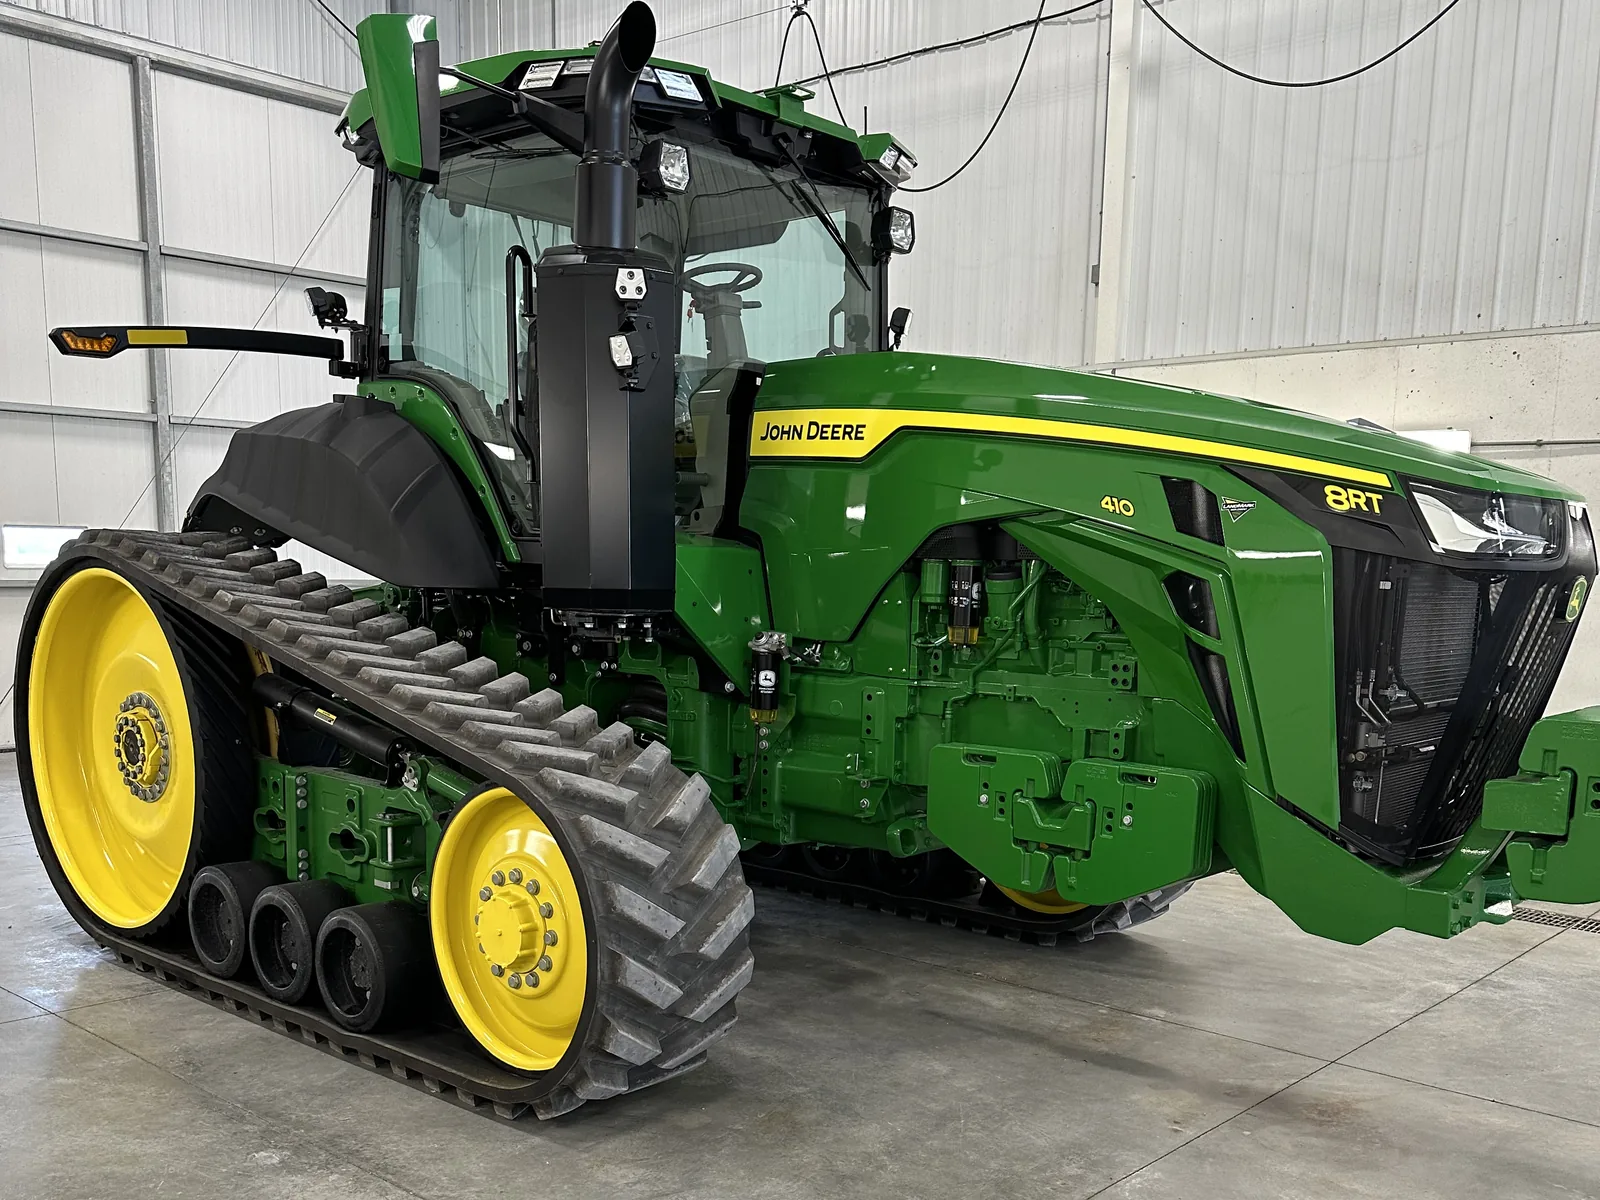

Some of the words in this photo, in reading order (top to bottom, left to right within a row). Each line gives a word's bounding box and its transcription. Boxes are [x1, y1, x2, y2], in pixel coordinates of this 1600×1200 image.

[759, 421, 804, 441] JOHN
[806, 420, 867, 441] DEERE
[1100, 495, 1135, 517] 410
[1323, 484, 1384, 514] 8RT
